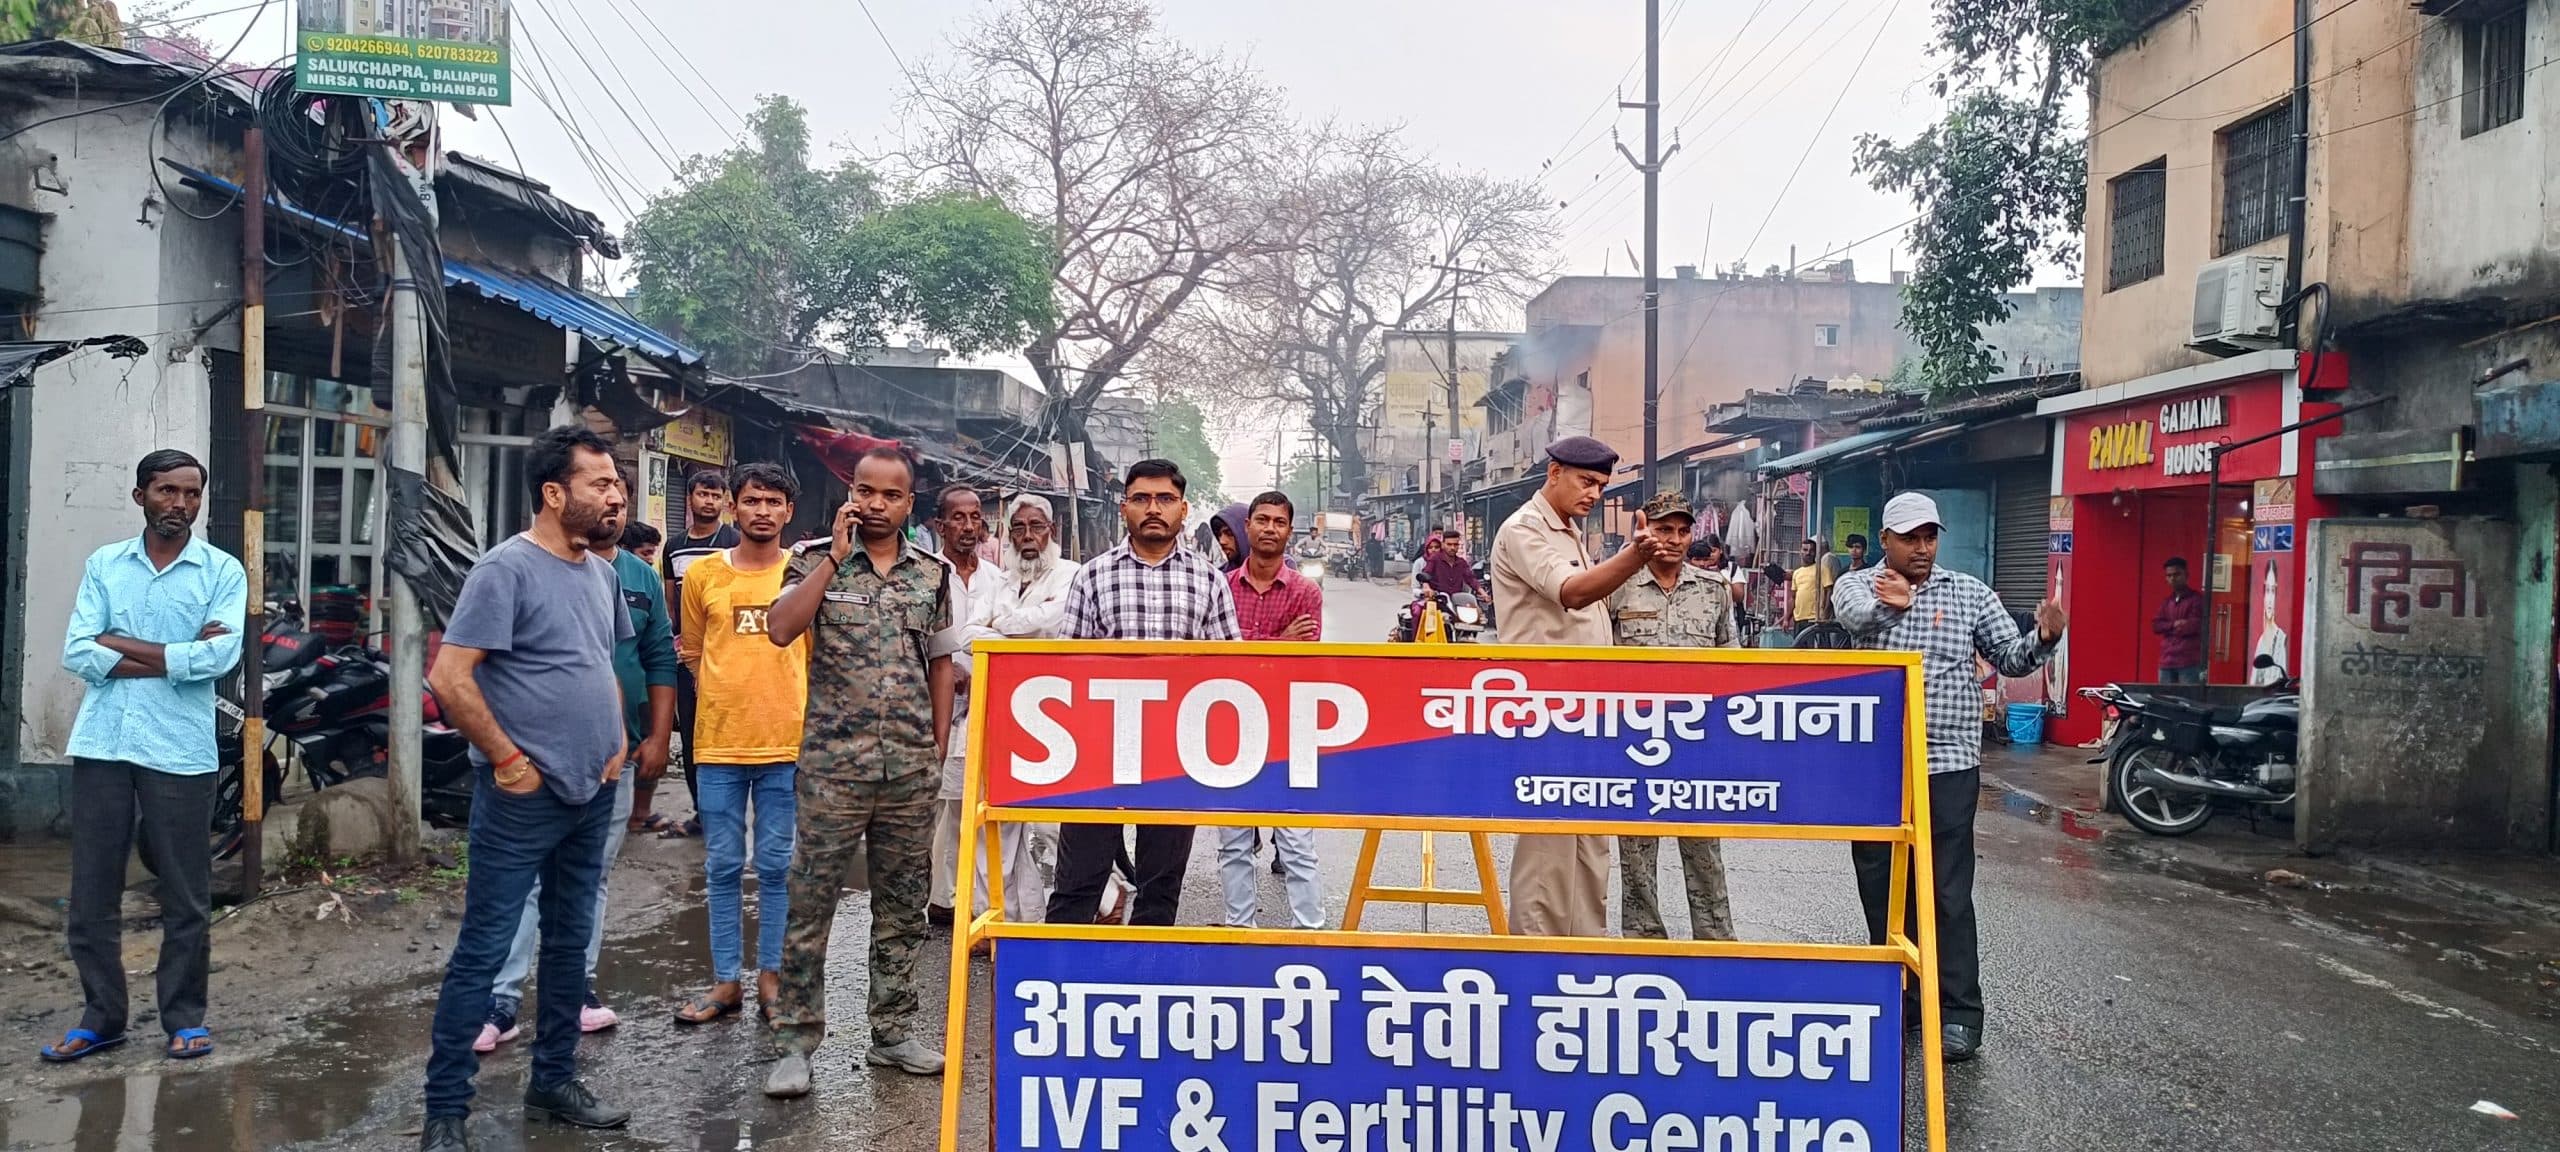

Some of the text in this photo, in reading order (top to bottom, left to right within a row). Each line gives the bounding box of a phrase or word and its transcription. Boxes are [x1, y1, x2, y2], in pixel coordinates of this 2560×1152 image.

[326, 37, 499, 65] 9204266944, 6207833223
[306, 73, 499, 98] NIRSA ROAD, DHANBAD
[307, 57, 498, 85] SALUKCHAPRA, BALIAPUR
[2158, 395, 2223, 434] GAHANA
[2163, 441, 2218, 476] HOUSE
[1010, 675, 1369, 789] STOP
[1420, 669, 1880, 766] बलियापुर थाना
[1515, 775, 1781, 815] धनबाद प्रशासन
[1013, 965, 1881, 1082] अलकारी देवी हॉस्पिटल
[1020, 1076, 1872, 1152] IVF & Fertility Centre
